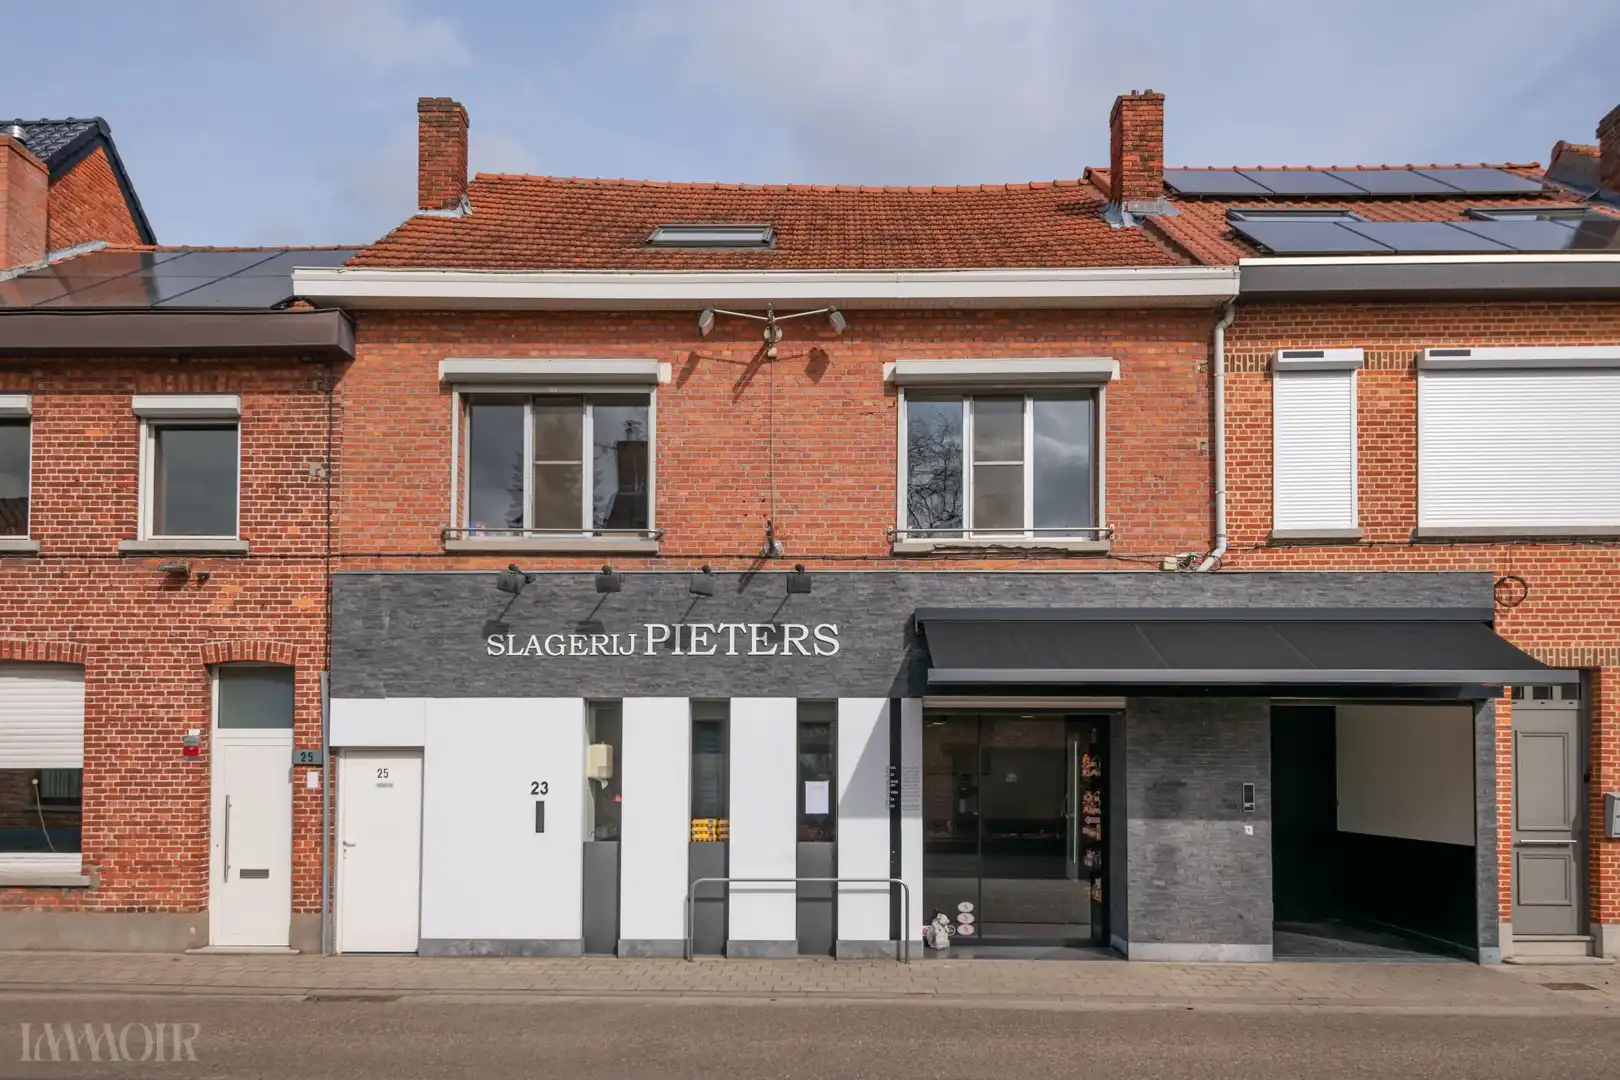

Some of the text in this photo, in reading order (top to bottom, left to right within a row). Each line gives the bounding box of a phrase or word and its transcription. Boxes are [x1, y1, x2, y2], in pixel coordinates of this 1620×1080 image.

[486, 623, 840, 657] SLAGERIJ PIETERS
[300, 751, 314, 762] 25
[376, 768, 389, 779] 25
[530, 781, 549, 795] 23
